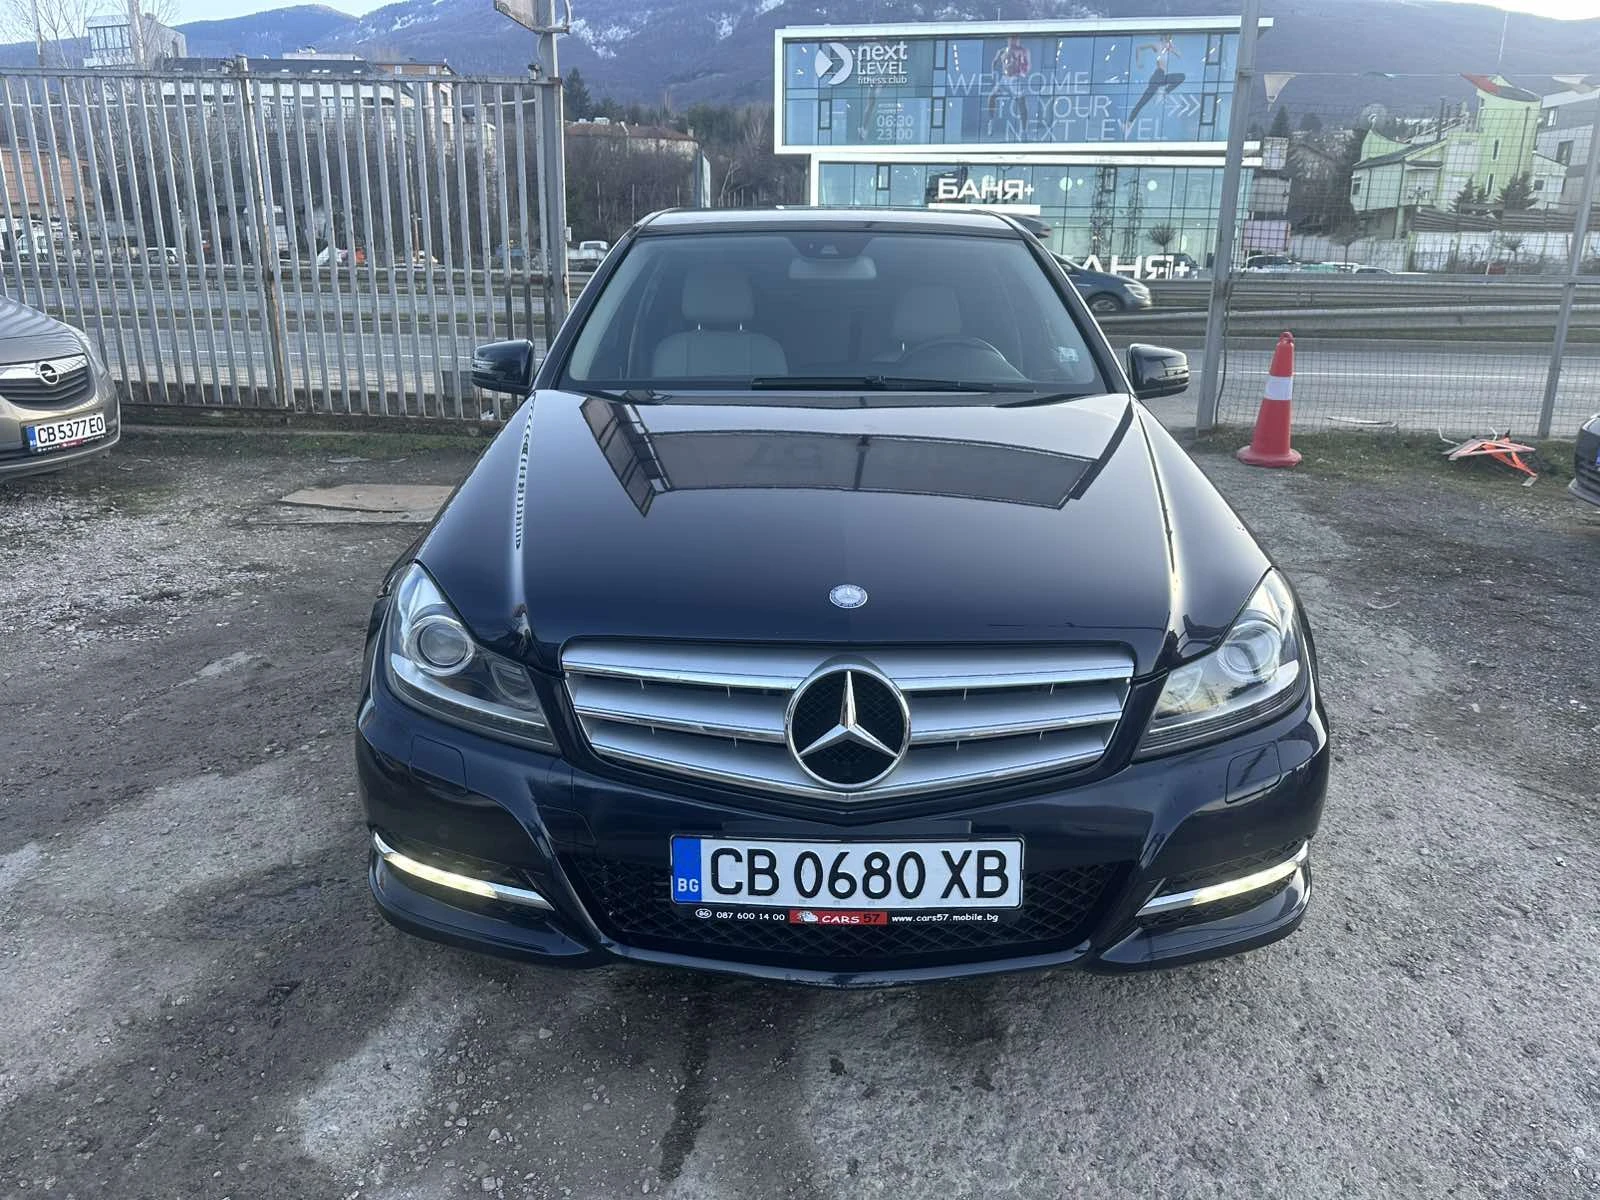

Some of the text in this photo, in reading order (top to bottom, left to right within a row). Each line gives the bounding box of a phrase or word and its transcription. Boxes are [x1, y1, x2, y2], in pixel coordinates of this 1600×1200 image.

[858, 41, 908, 60] next
[857, 61, 907, 74] LEVEL
[858, 75, 907, 84] fitness club
[1039, 95, 1112, 118] YOUR
[1005, 118, 1167, 141] NEXT LEVEL
[938, 177, 1034, 200] БАНЯ+
[1078, 254, 1190, 279] АНЯ+
[38, 426, 57, 443] CB
[58, 420, 87, 440] 5377
[711, 847, 1009, 899] CB 0680 XB
[677, 878, 699, 892] BG
[716, 911, 734, 919] 087
[737, 912, 756, 920] 600
[772, 913, 785, 921] 00
[821, 915, 860, 924] CARS
[863, 914, 881, 923] 57
[891, 913, 999, 923] www.cars57.mobile.bg
